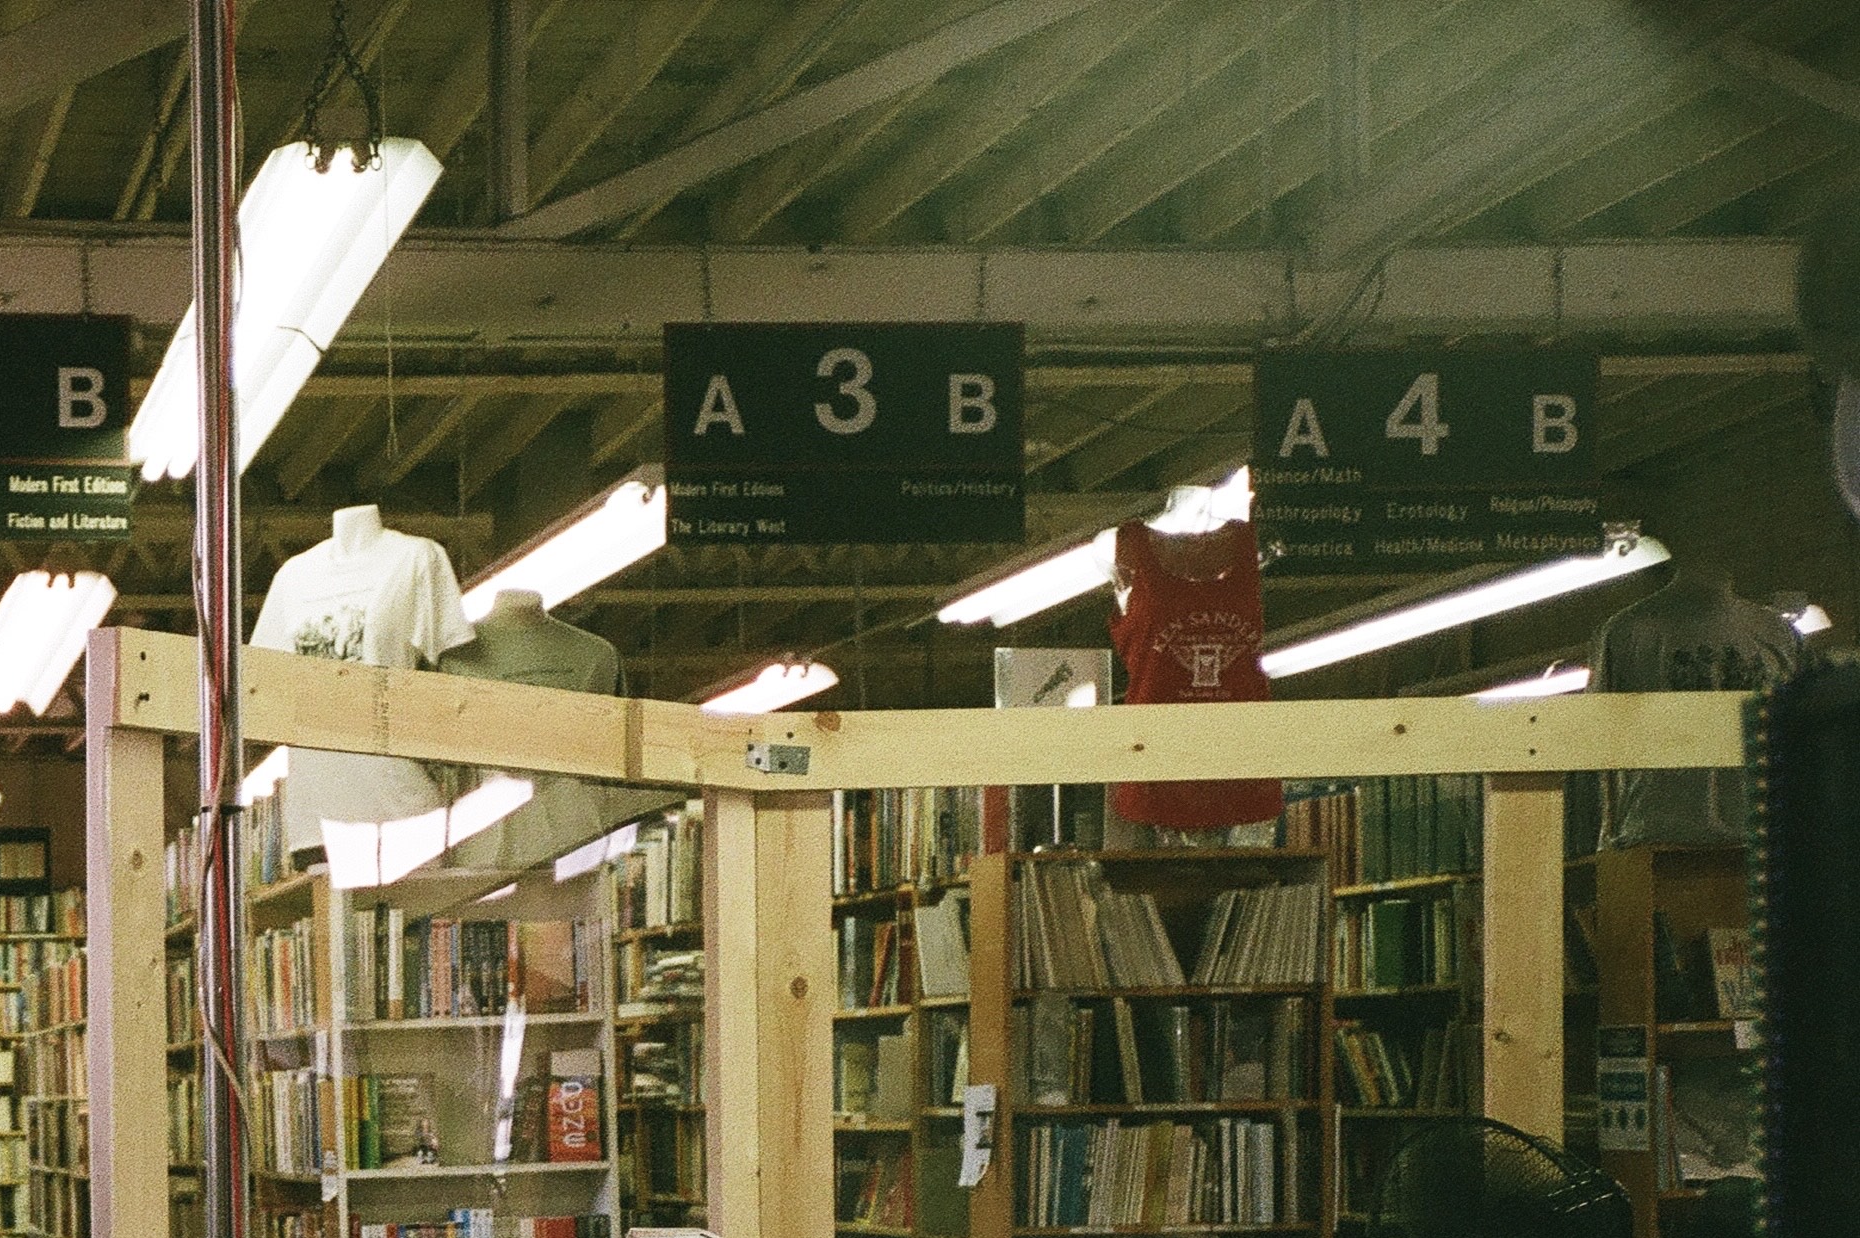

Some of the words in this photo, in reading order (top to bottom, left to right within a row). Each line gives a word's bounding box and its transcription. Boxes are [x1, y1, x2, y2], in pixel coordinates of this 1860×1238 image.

[57, 366, 108, 428] B
[693, 374, 745, 436] A
[813, 346, 878, 435] 3
[948, 373, 998, 435] B
[1278, 397, 1330, 458] A
[1385, 372, 1451, 456] 4
[1531, 394, 1579, 454] B
[52, 475, 80, 494] First
[83, 475, 129, 495] Editions
[711, 481, 739, 498] First
[7, 512, 46, 531] Fiction
[48, 513, 69, 531] and
[72, 513, 129, 532] Literature
[1254, 505, 1363, 524] Anthropology
[671, 518, 692, 535] The
[1264, 539, 1354, 558] ermetica
[560, 1081, 587, 1149] DUNE
